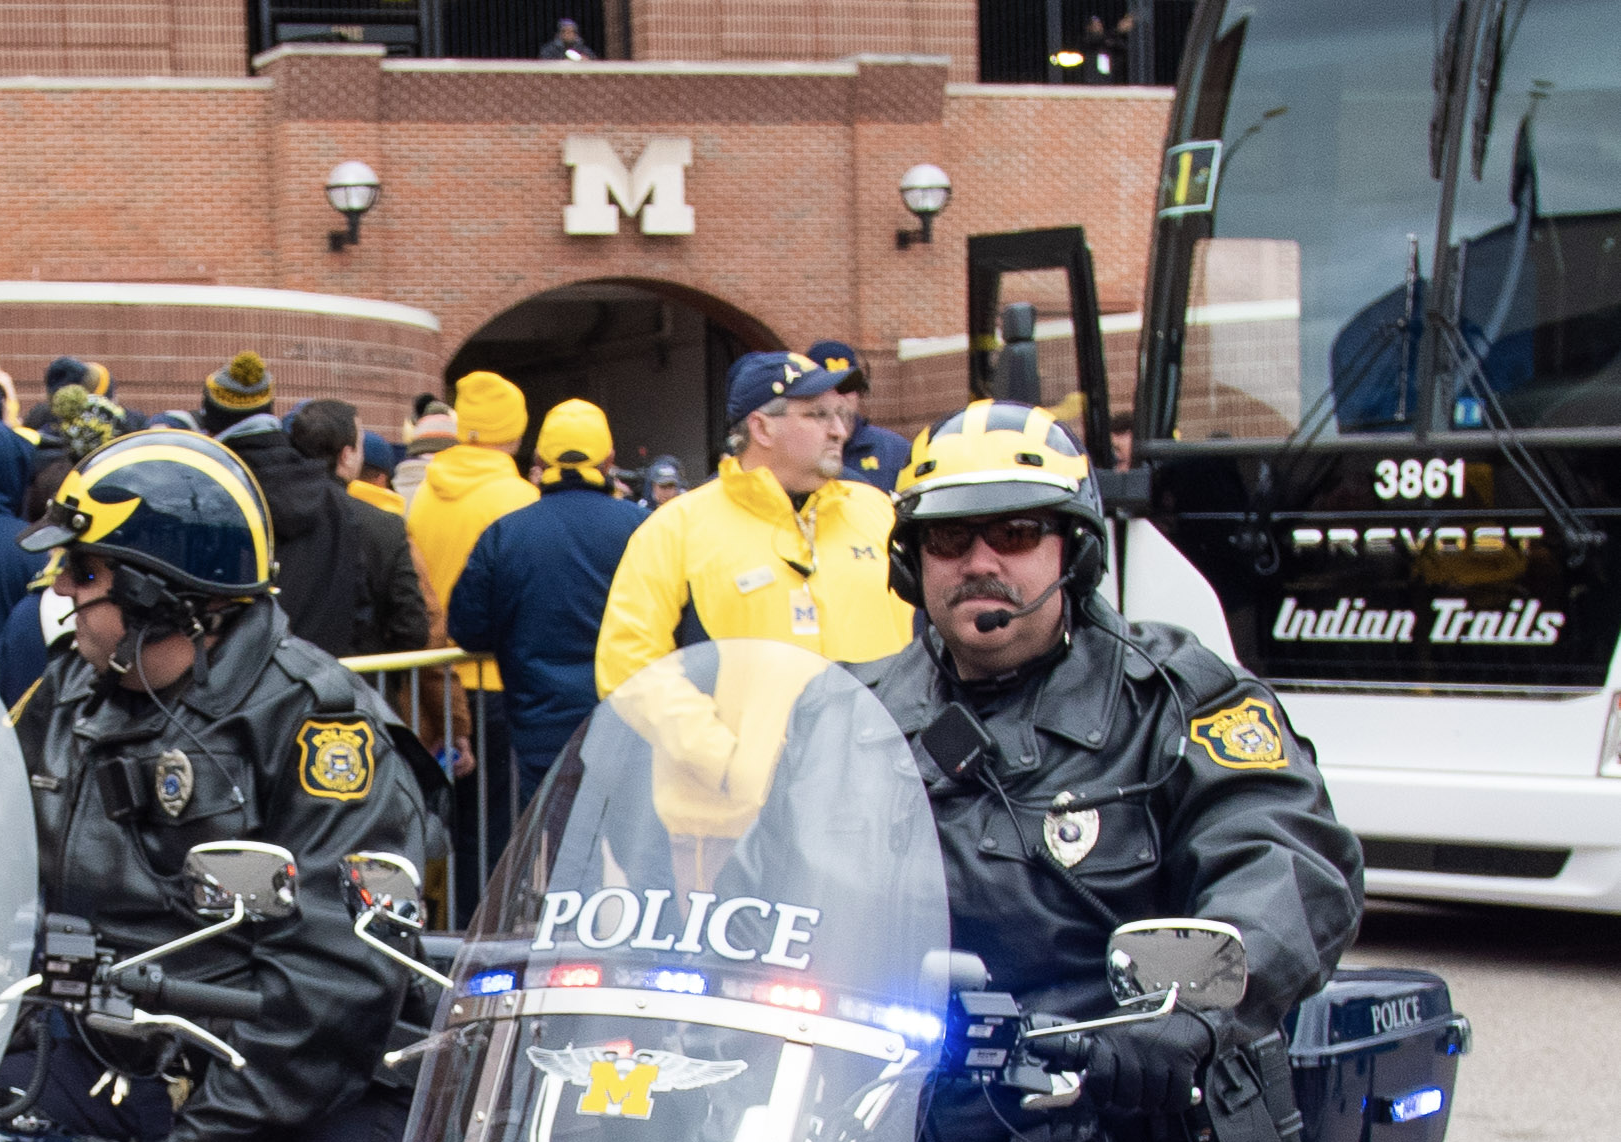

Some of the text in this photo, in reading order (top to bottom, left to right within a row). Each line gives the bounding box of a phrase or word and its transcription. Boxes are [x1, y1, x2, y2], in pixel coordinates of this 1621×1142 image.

[563, 133, 695, 235] M
[1374, 458, 1465, 500] 3861
[850, 546, 877, 560] M
[1292, 527, 1544, 556] PREVOST
[1272, 597, 1566, 645] Indian Trails
[530, 886, 821, 971] POLICE
[1370, 995, 1422, 1035] POLICE
[578, 1070, 660, 1119] M
